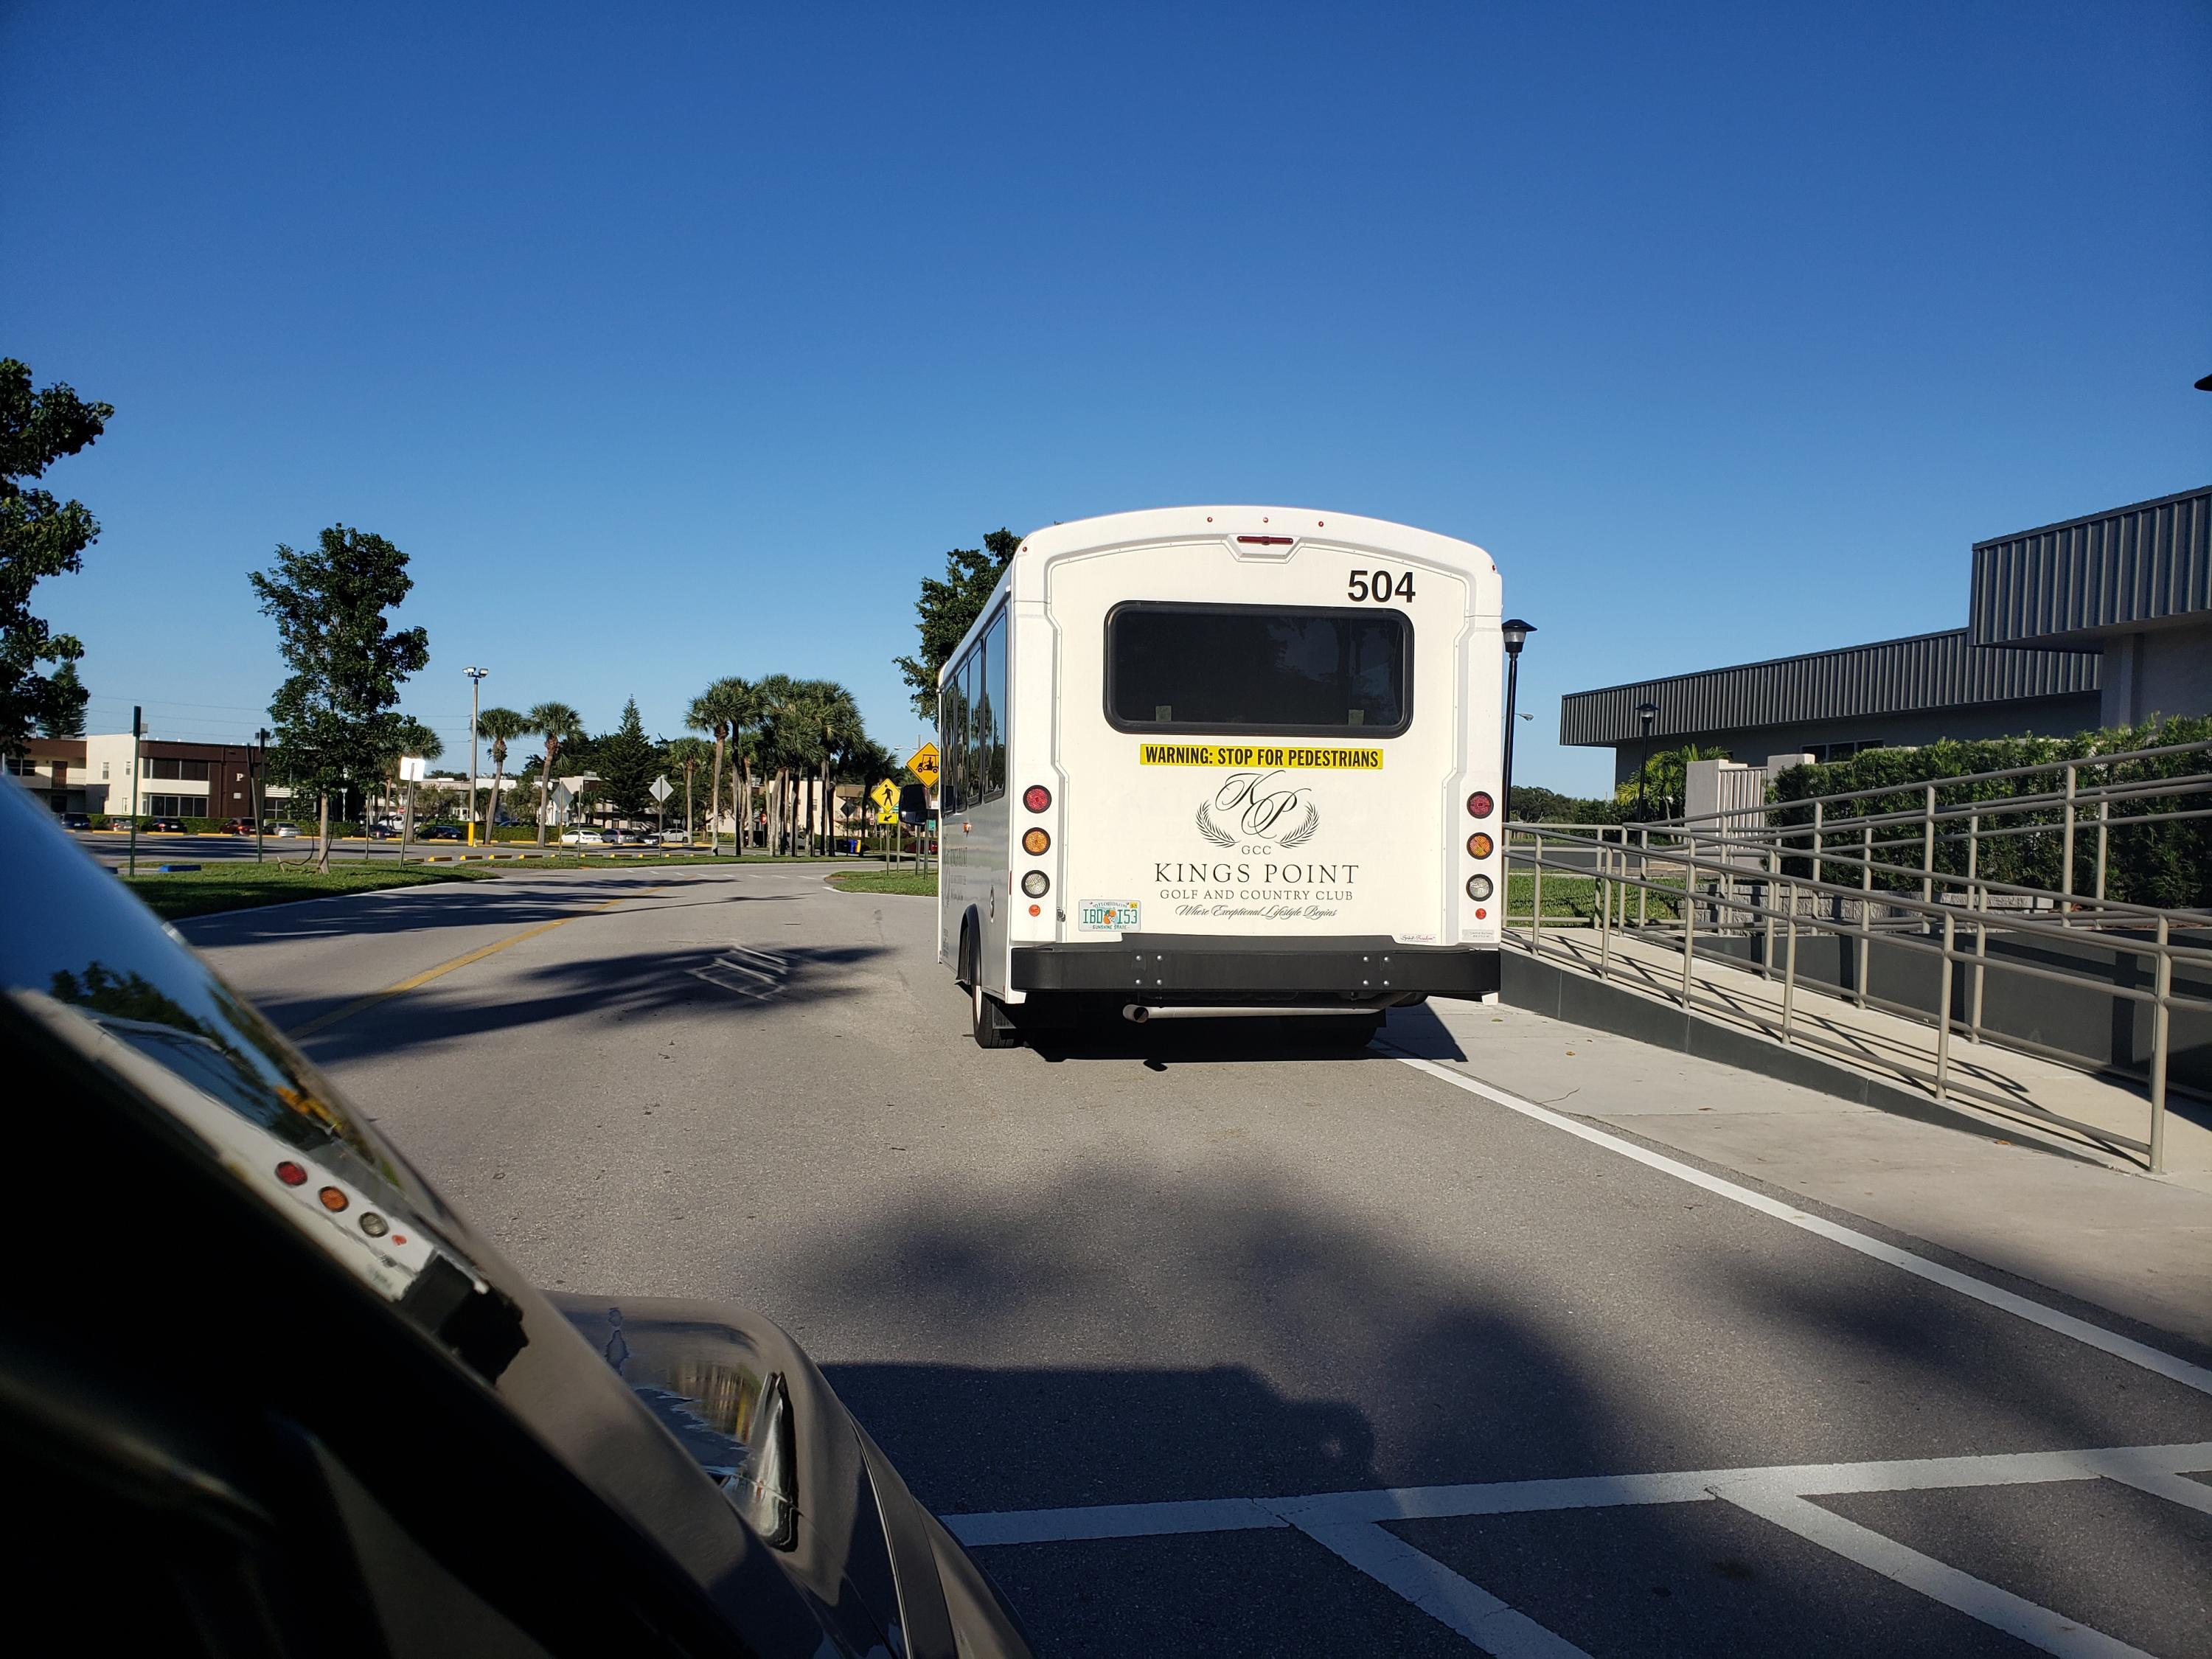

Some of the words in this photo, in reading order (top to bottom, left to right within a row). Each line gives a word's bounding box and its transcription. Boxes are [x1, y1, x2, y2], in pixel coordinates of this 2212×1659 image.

[1347, 570, 1416, 603] 504
[1146, 746, 1213, 764] WARNING:
[1217, 748, 1253, 765] STOP
[1257, 748, 1283, 766] FOR
[1288, 749, 1378, 768] PEDESTRIANS
[1241, 845, 1271, 855] GCC
[1155, 863, 1251, 883] KINGS
[1264, 863, 1359, 884] POINT
[1160, 889, 1198, 900] GOLF
[1203, 889, 1234, 900] AND
[1240, 890, 1310, 901] COUNTRY
[1315, 891, 1353, 901] CLUB
[1175, 905, 1210, 917] Where
[1211, 905, 1263, 920] Exceptional
[1260, 904, 1302, 920] Lifestyle
[1302, 905, 1338, 920] Begins
